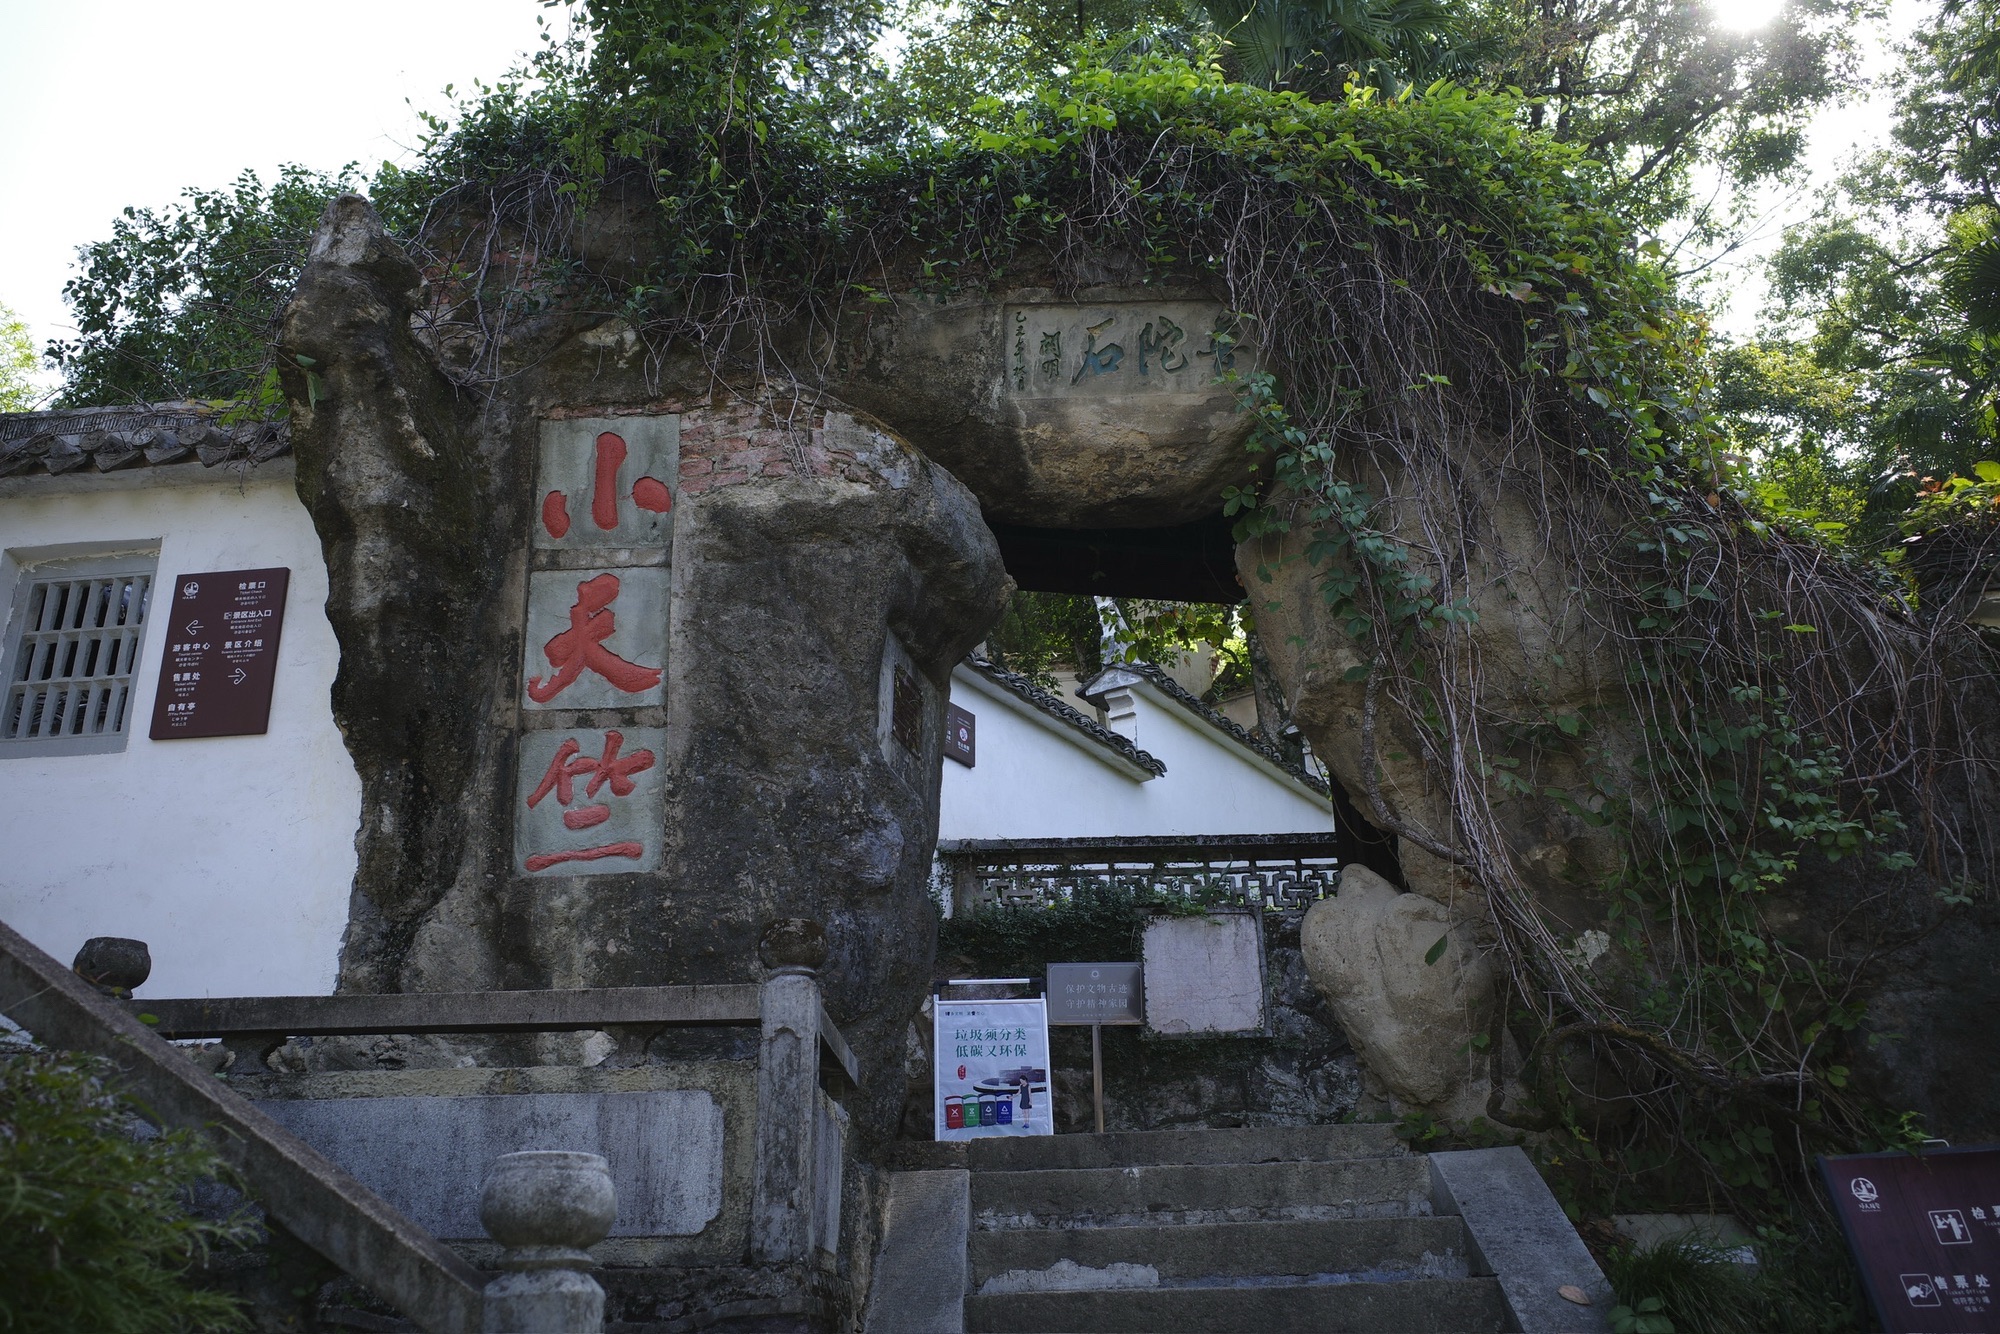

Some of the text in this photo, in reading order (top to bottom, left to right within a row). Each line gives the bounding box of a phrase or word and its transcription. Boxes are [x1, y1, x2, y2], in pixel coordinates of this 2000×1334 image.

[239, 581, 266, 590] 检票口
[232, 609, 272, 619] 景区出入口
[172, 642, 210, 652] 游客中心
[224, 639, 263, 649] 景区介绍
[524, 431, 672, 872] 小天竺
[173, 672, 201, 682] 售票处
[167, 702, 196, 711] 自有亭
[1065, 983, 1129, 995] 保护文物古迹
[1065, 998, 1129, 1010] 守护精神家园
[954, 1027, 1027, 1042] 垃圾须分类
[955, 1044, 1028, 1058] 低碳又环保
[1934, 1274, 1991, 1290] 售票处
